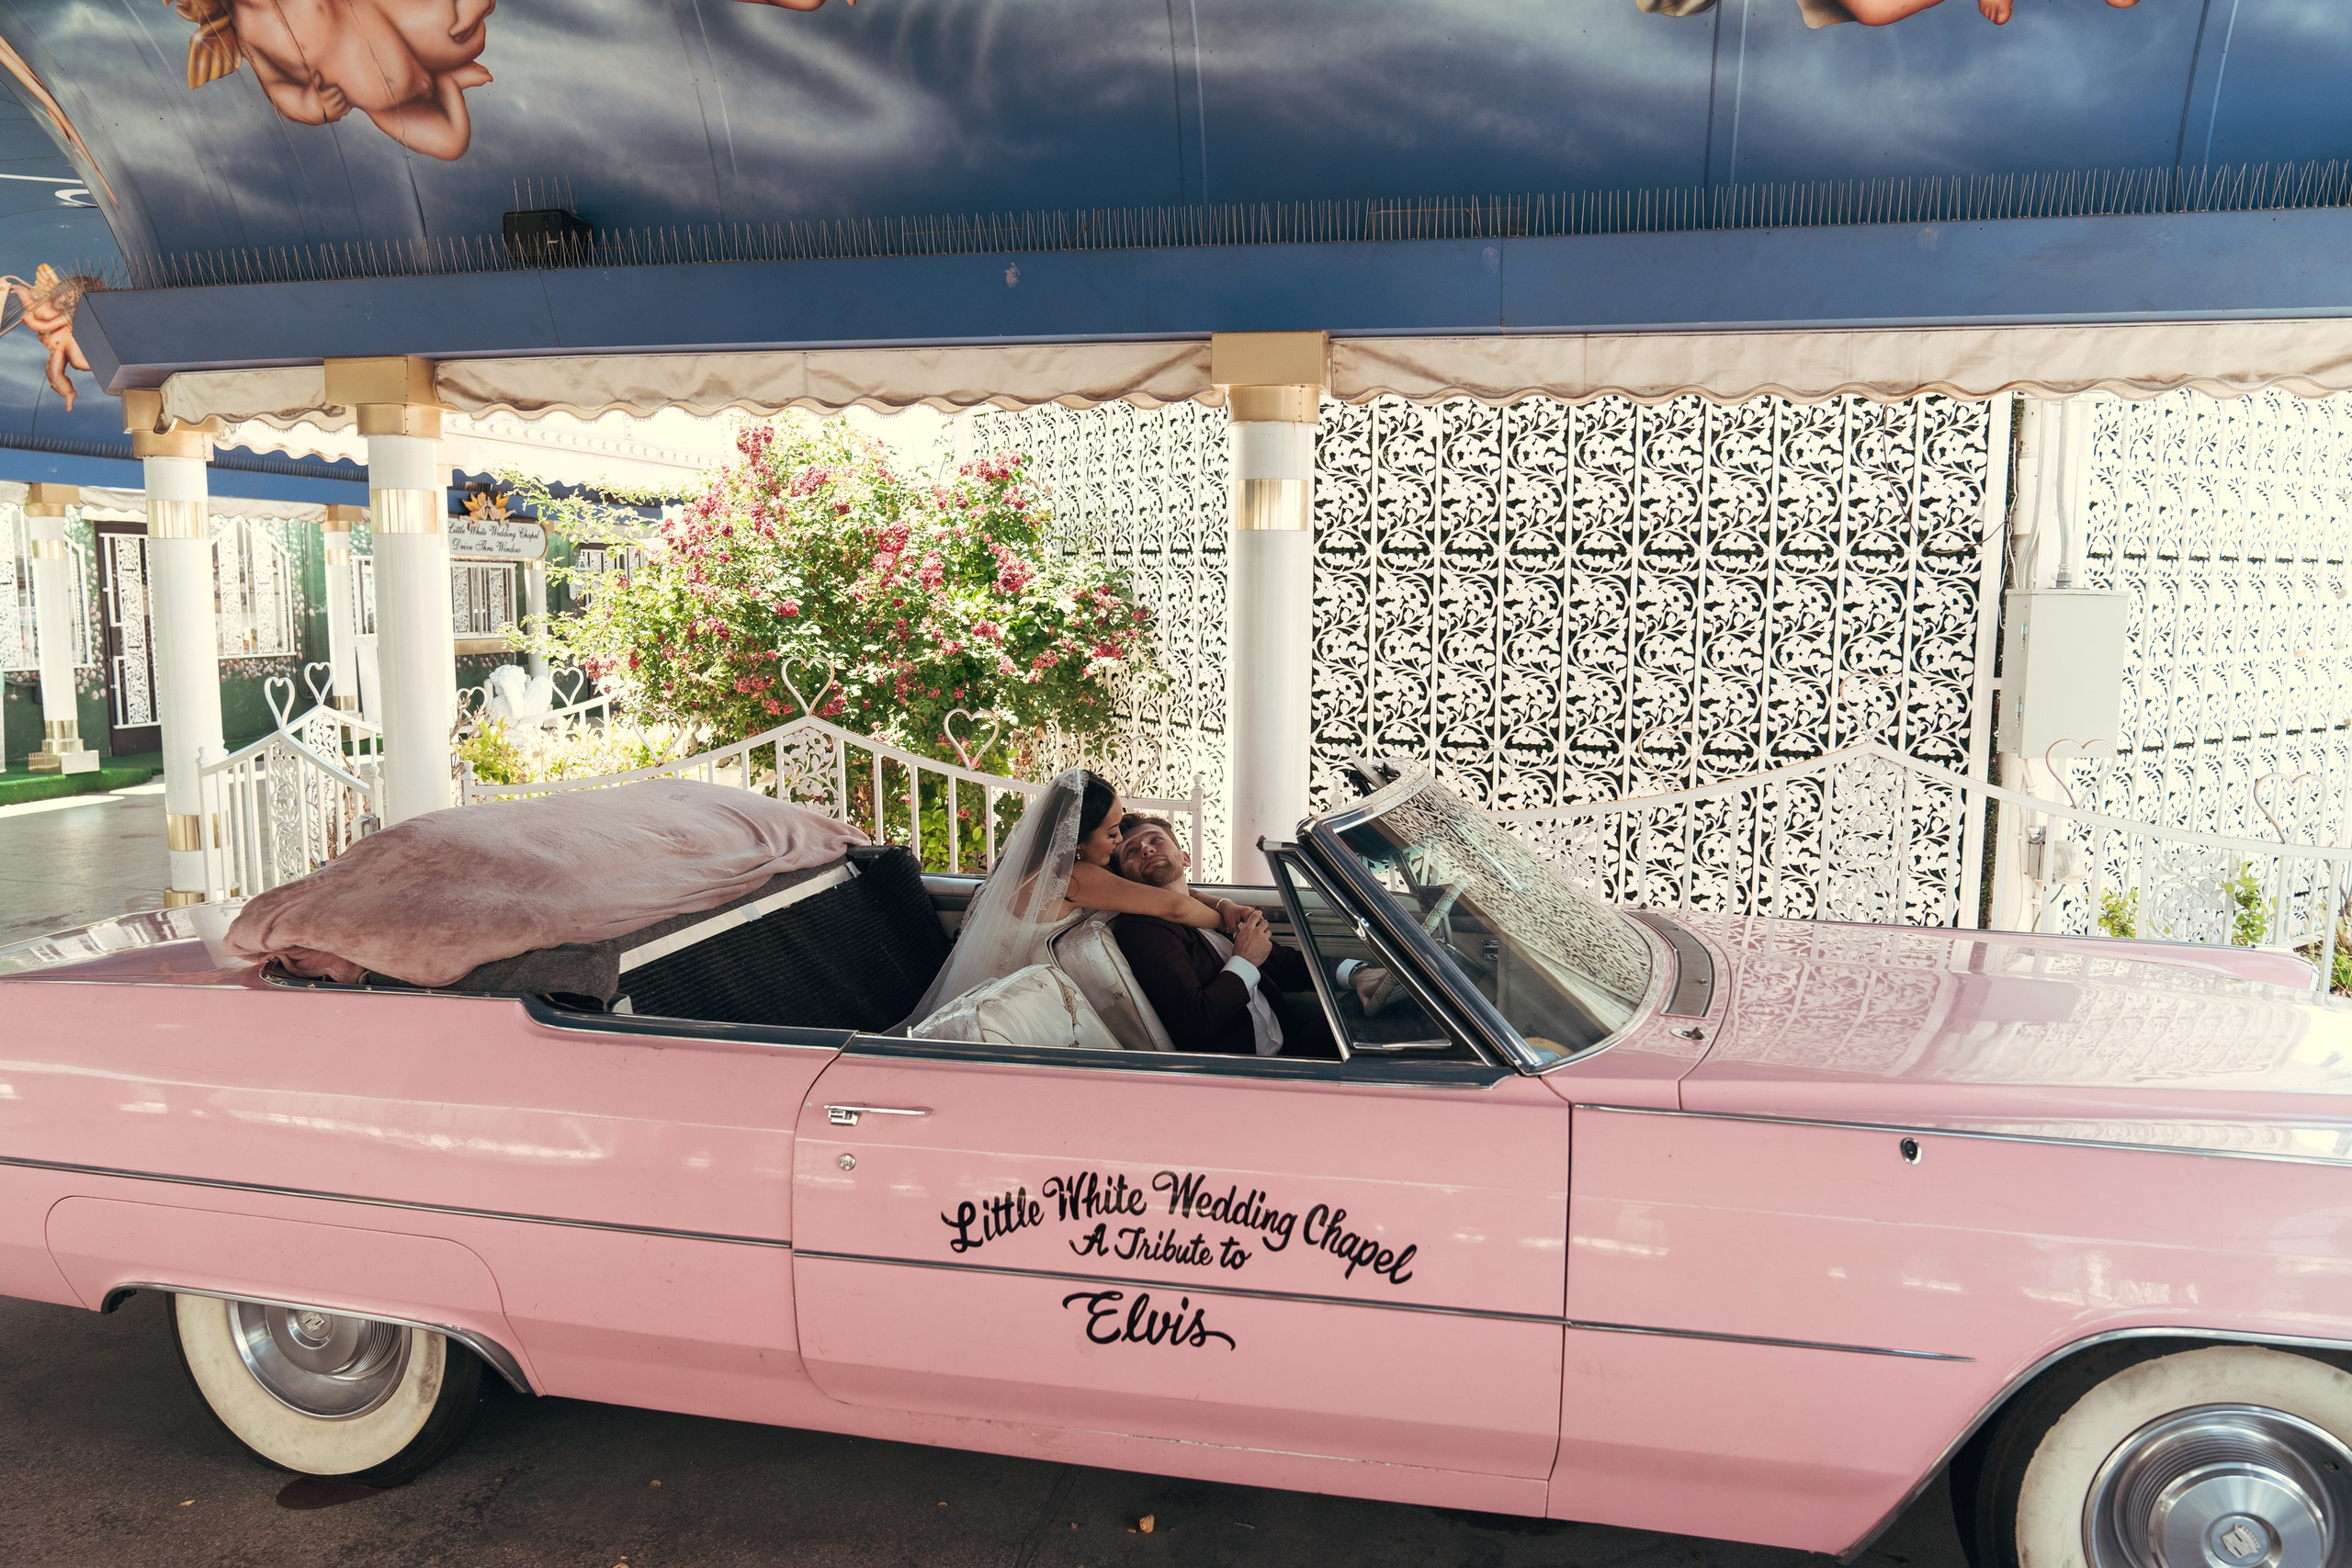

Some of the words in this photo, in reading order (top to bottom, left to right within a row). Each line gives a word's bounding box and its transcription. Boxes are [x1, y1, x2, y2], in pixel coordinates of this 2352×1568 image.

[448, 521, 465, 535] Little
[469, 526, 487, 536] White
[489, 525, 516, 541] Wedding
[518, 526, 540, 542] Chapel
[452, 537, 473, 551] Drive
[474, 539, 493, 552] Thru
[496, 540, 522, 554] Window
[941, 1186, 1045, 1254] Little
[1042, 1171, 1148, 1222] White
[1151, 1171, 1298, 1252] Wedding
[1303, 1203, 1418, 1285] Chapel
[1069, 1223, 1110, 1258] A
[1114, 1226, 1214, 1268] Tribute
[1219, 1235, 1252, 1270] to
[1062, 1290, 1237, 1351] Elvis
